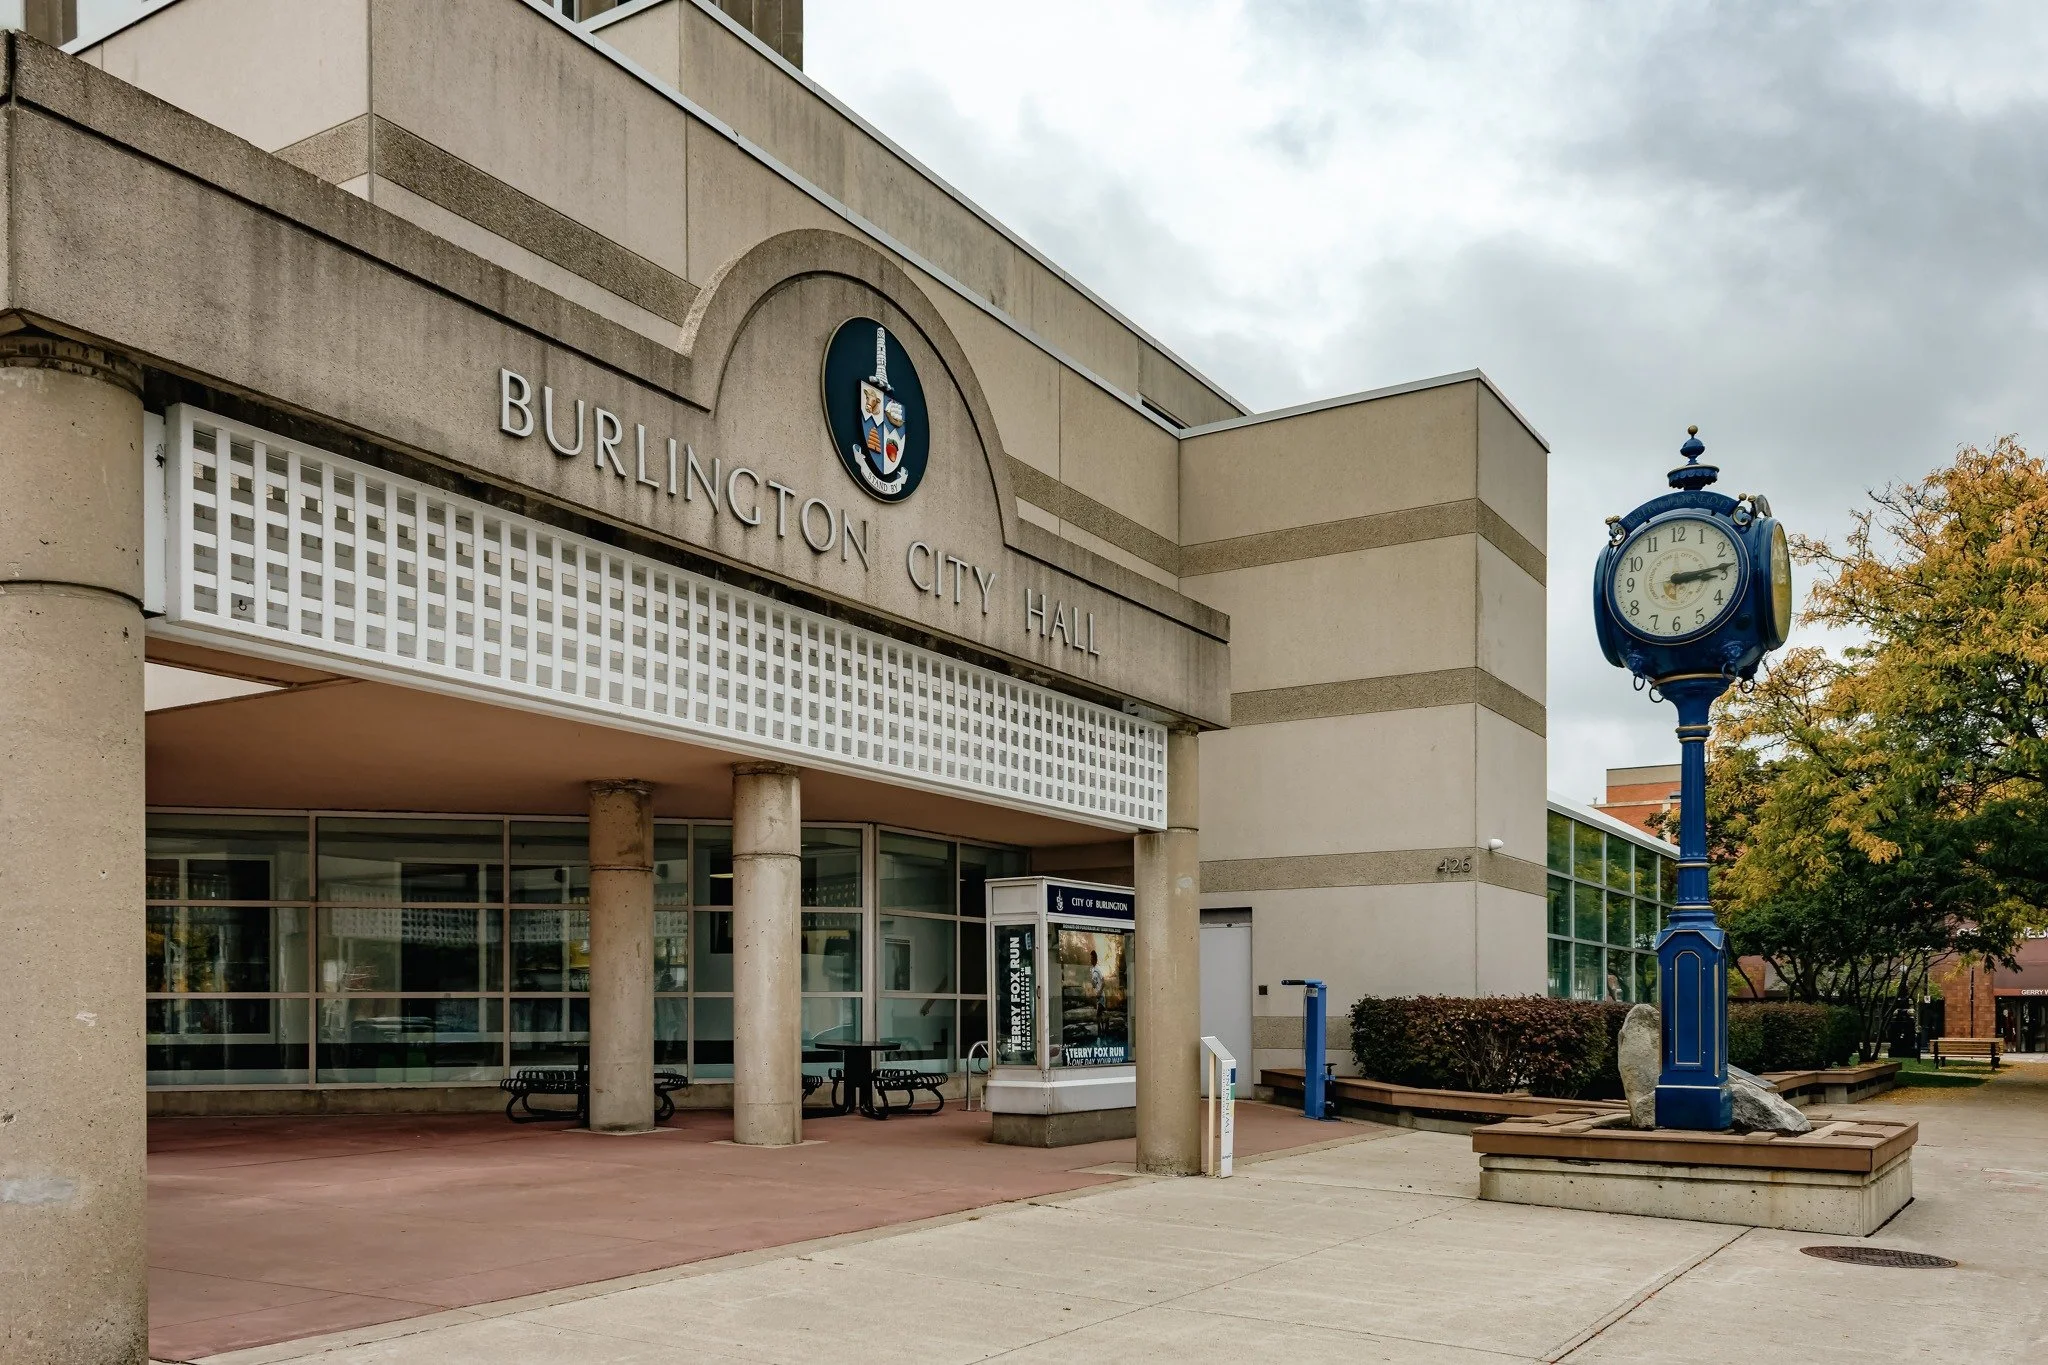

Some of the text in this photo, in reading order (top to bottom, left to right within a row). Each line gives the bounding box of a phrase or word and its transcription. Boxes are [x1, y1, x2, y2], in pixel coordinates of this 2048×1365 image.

[867, 472, 898, 492] STAND BY
[500, 367, 1101, 656] BURLINGTON CITY HALL
[1671, 527, 1686, 543] 12
[1699, 529, 1705, 544] 1
[1646, 537, 1659, 553] 11
[1717, 541, 1728, 558] 2
[1629, 556, 1644, 573] 10
[1719, 567, 1729, 581] 3
[1626, 577, 1636, 594] 9
[1713, 589, 1724, 606] 4
[1630, 600, 1640, 616] 8
[1695, 607, 1706, 625] 5
[1649, 614, 1660, 631] 7
[1672, 616, 1682, 632] 6
[1438, 856, 1472, 873] 426
[1071, 897, 1127, 911] CITY OF BURLINGTON
[1010, 937, 1021, 1052] TERRY FOX RUN
[1069, 1046, 1124, 1058] TERRY FOX RUN
[1072, 1058, 1084, 1066] ONE
[1084, 1058, 1096, 1066] DAY
